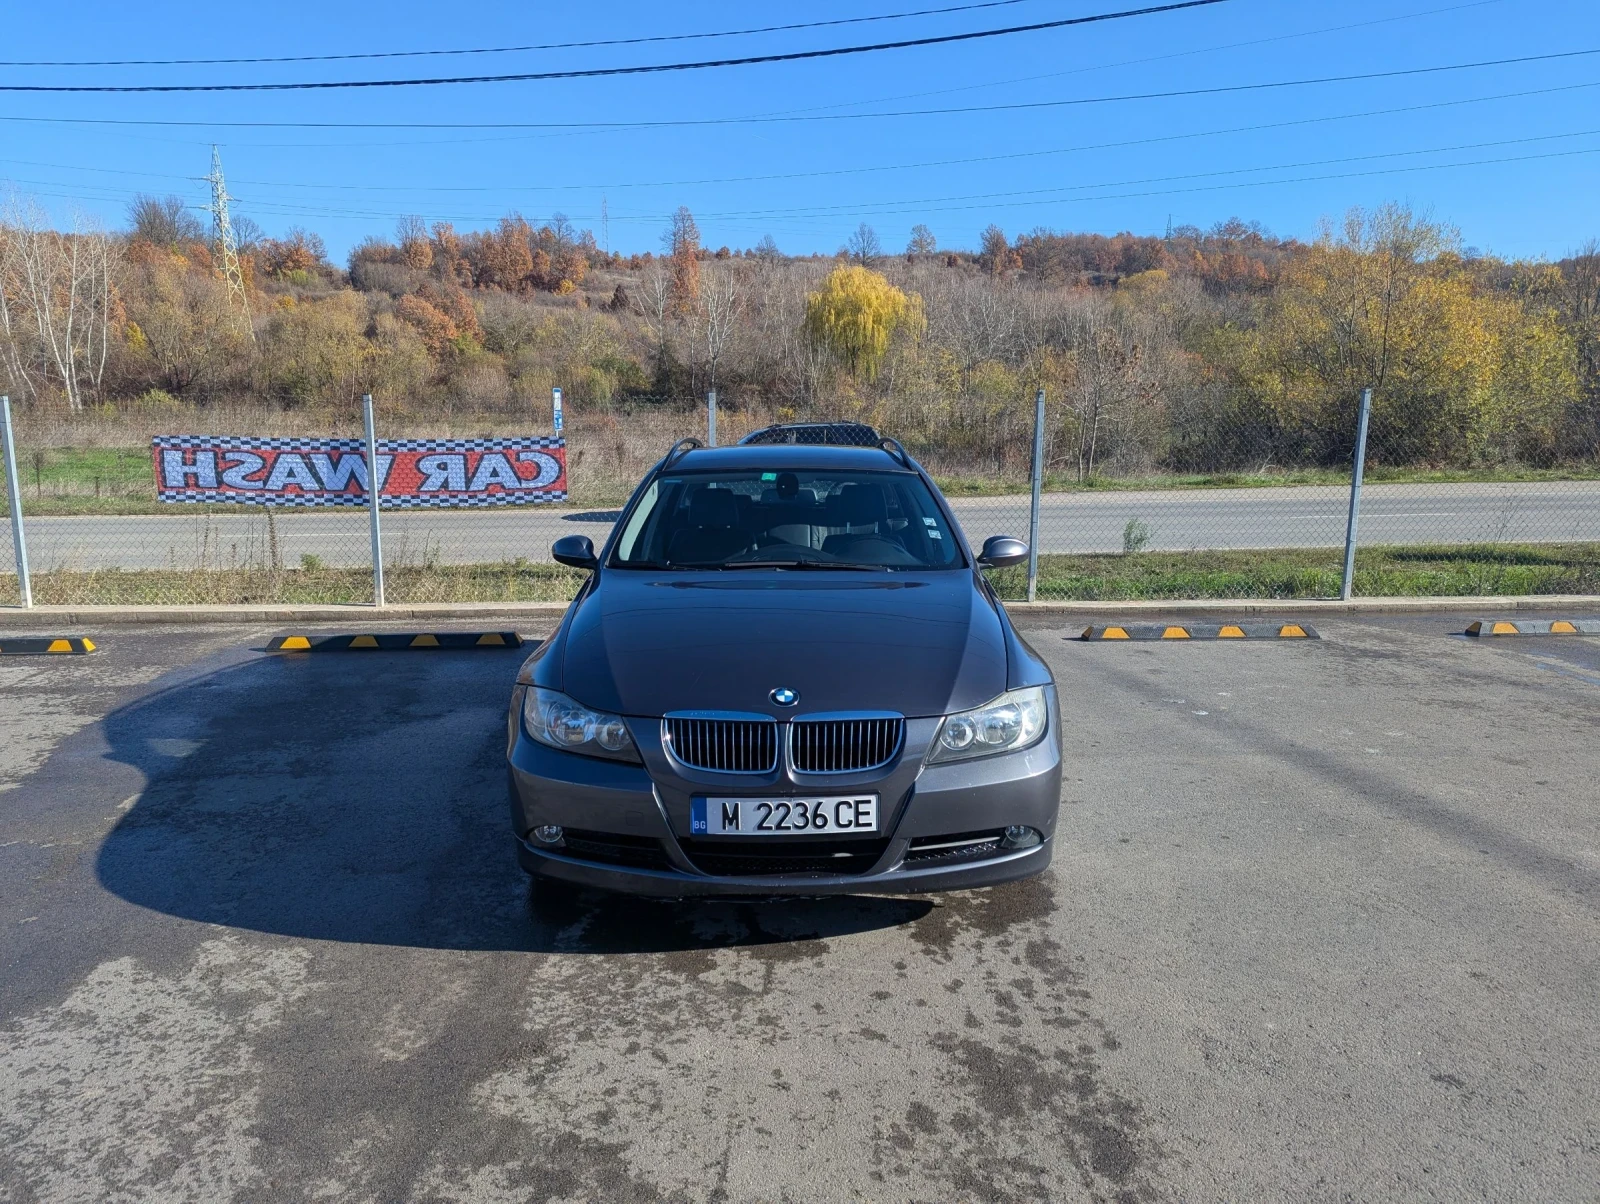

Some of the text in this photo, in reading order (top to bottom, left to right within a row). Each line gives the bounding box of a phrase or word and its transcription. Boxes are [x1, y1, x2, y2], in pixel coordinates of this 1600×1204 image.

[694, 820, 706, 830] BG
[722, 800, 873, 831] M 2236 CE
